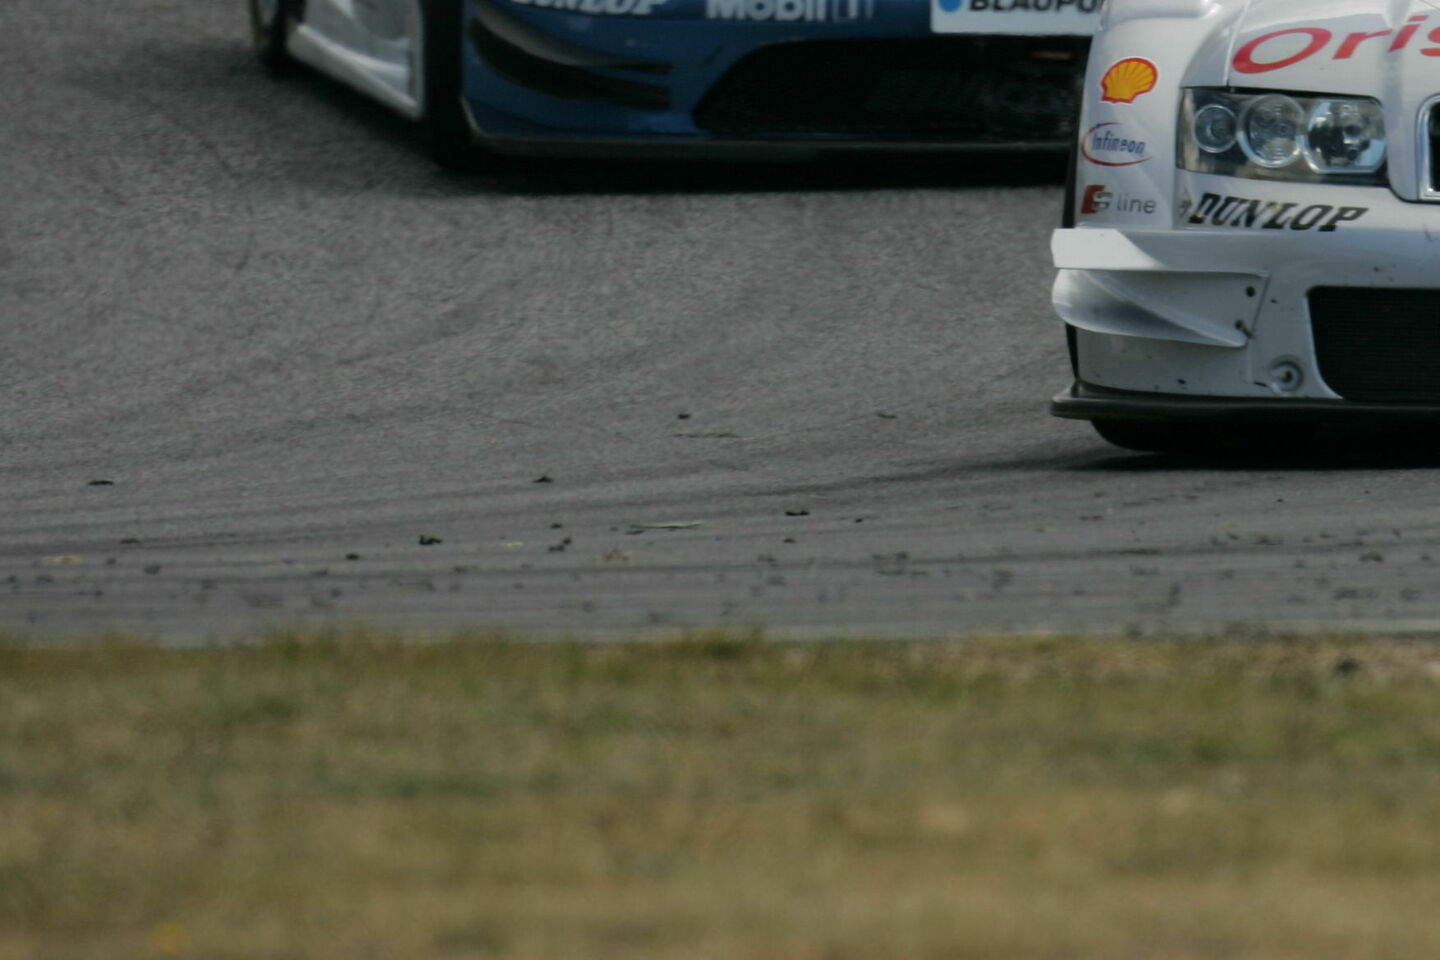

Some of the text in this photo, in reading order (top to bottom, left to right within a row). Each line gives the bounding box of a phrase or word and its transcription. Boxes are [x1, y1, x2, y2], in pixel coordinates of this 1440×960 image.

[1091, 130, 1147, 155] Infineon
[1117, 193, 1156, 215] line
[1189, 192, 1369, 232] DUNLOP
